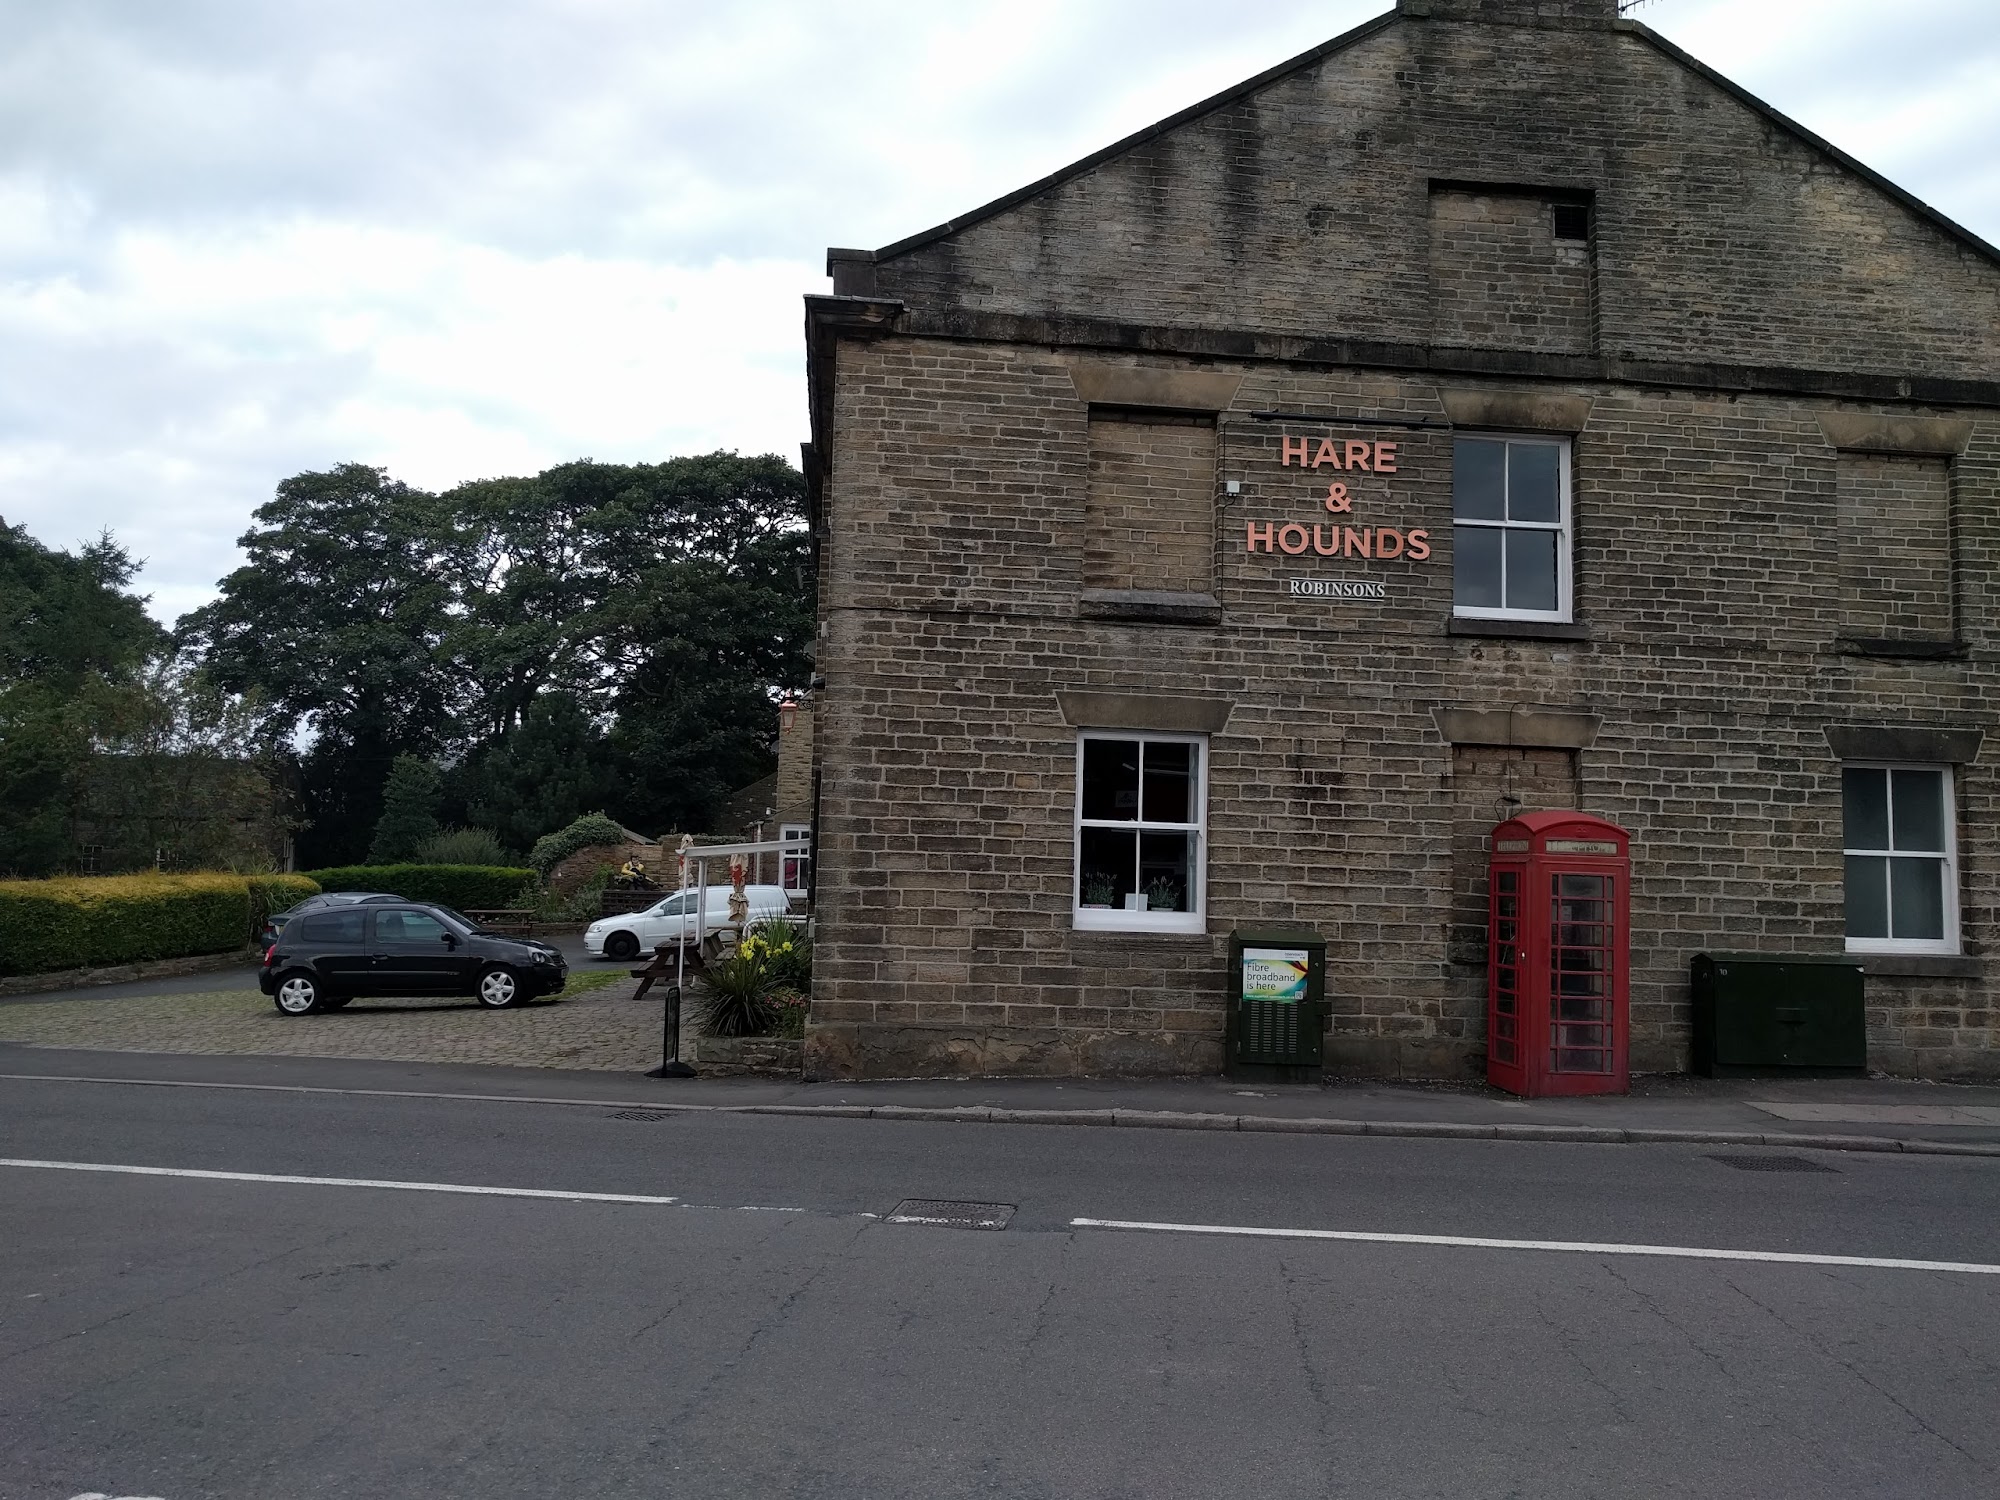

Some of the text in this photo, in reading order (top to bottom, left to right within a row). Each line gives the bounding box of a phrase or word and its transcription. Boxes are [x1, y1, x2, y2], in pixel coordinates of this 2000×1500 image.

[1281, 436, 1398, 473] HARE
[1325, 482, 1352, 513] &
[1247, 522, 1431, 560] HOUNDS
[1290, 581, 1386, 598] ROBINSONS
[1247, 962, 1270, 971] Fibre
[1246, 972, 1296, 982] broadband
[1246, 981, 1276, 991] is here
